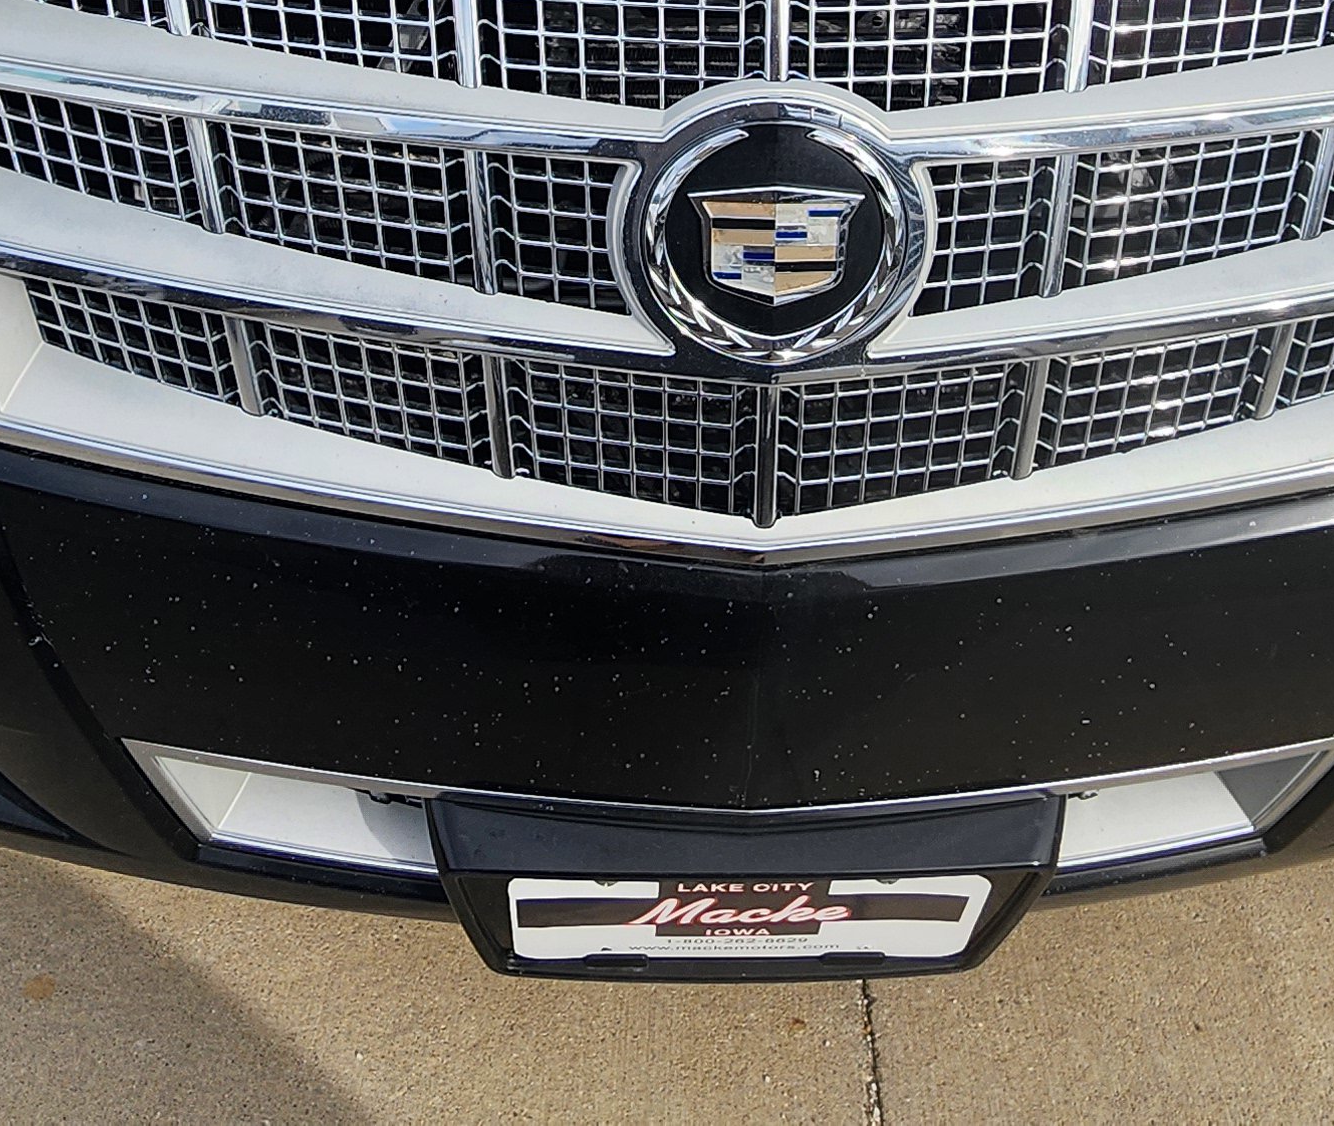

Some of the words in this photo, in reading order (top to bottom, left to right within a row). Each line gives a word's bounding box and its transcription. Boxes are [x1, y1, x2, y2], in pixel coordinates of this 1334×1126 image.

[676, 882, 744, 893] LAKE
[752, 882, 815, 893] CITY
[626, 894, 851, 925] Macke
[705, 927, 771, 936] IOWA
